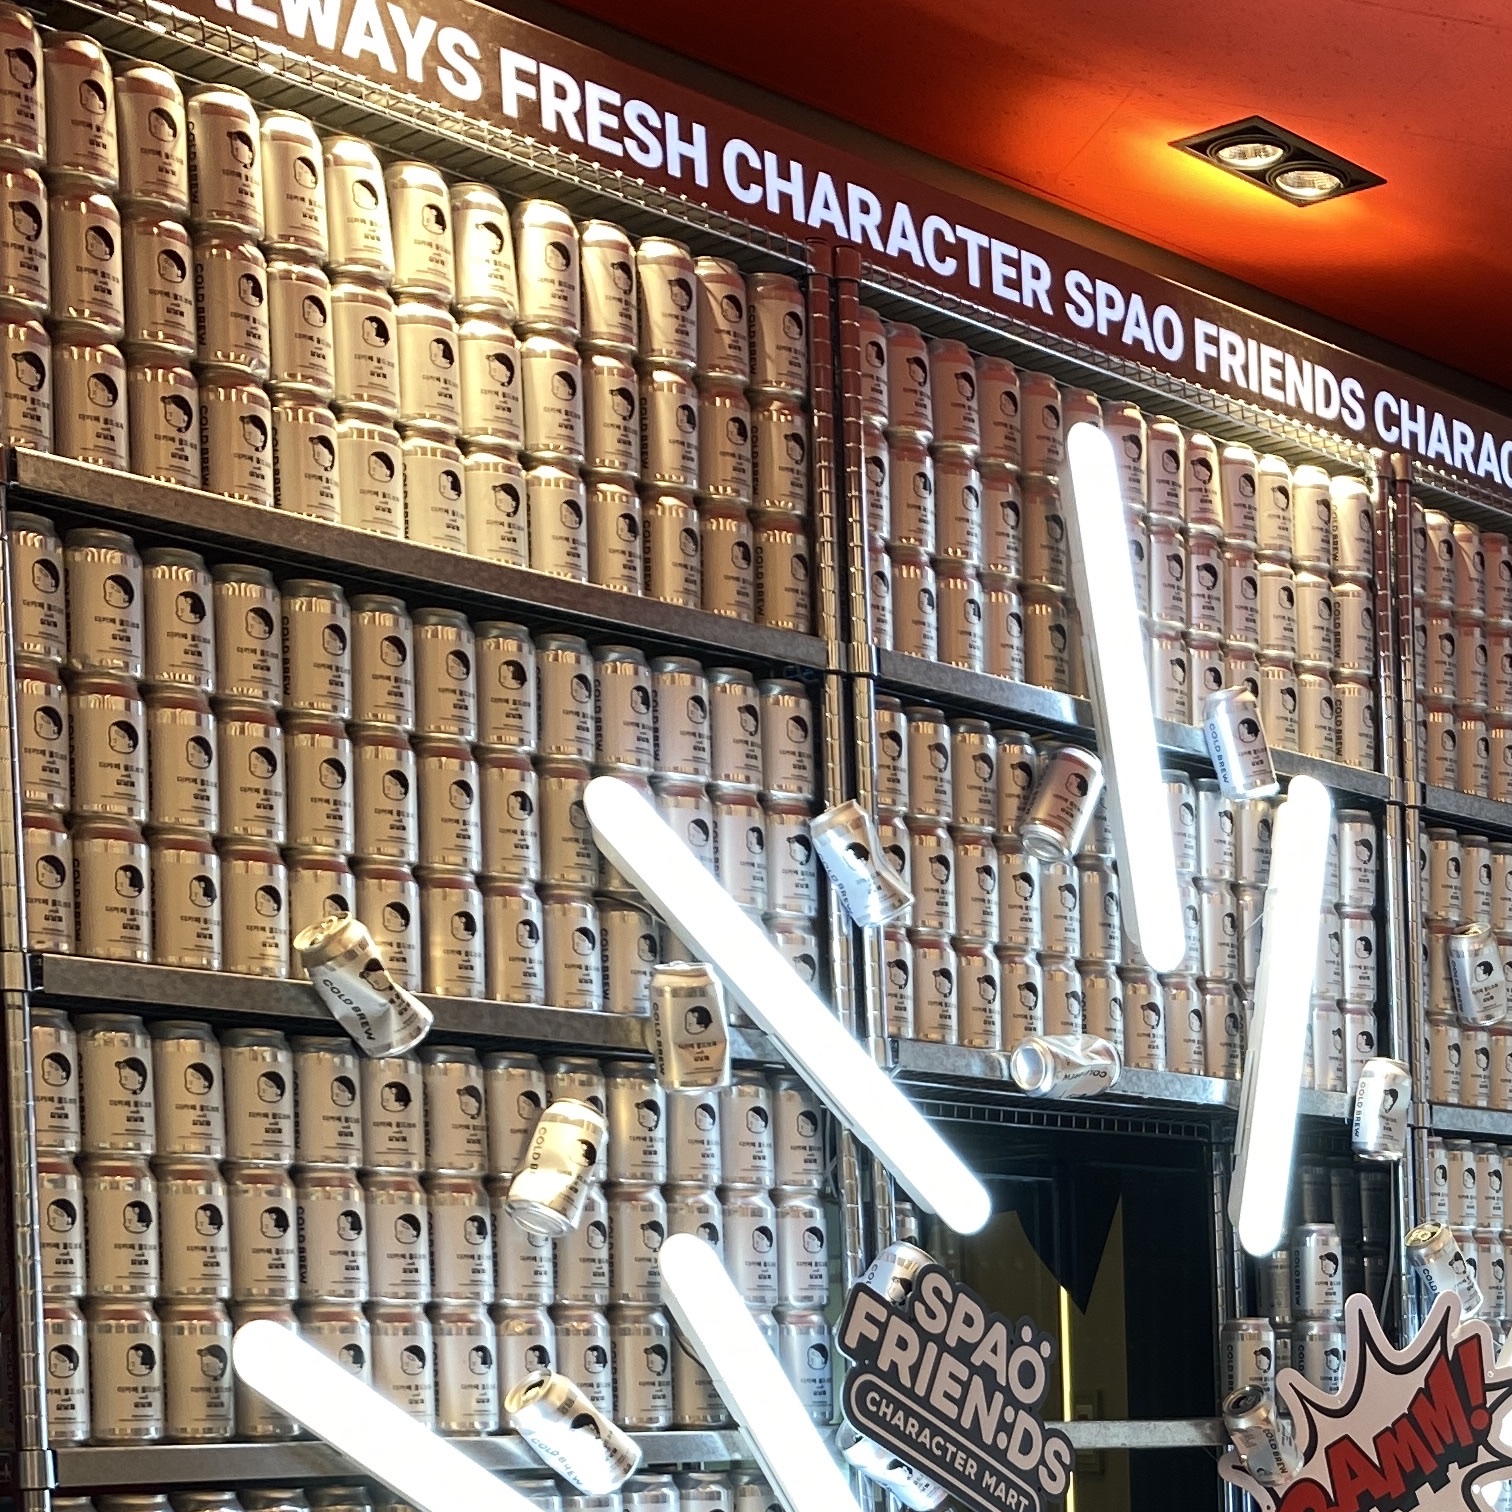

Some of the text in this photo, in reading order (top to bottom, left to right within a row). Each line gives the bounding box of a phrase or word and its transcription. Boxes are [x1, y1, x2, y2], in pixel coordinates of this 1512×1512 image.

[213, 0, 482, 101] WAYS
[500, 47, 709, 188] FRESH
[722, 137, 1052, 315] CHARACTER
[1065, 269, 1184, 361] SPAO
[1195, 317, 1366, 431] FRIENDS
[1209, 723, 1229, 784] COLD BREW
[323, 979, 375, 1040] COLD BREW
[652, 1002, 665, 1075] COLD BREW
[1354, 1082, 1366, 1138] COLD BREW
[532, 1127, 546, 1161] COLD
[297, 1206, 307, 1283] COLD BREW
[1422, 1268, 1437, 1293] COLD
[530, 1437, 584, 1486] COLD BREW
[863, 1389, 978, 1482] CHARACTER
[1265, 1429, 1288, 1474] COLD BREW
